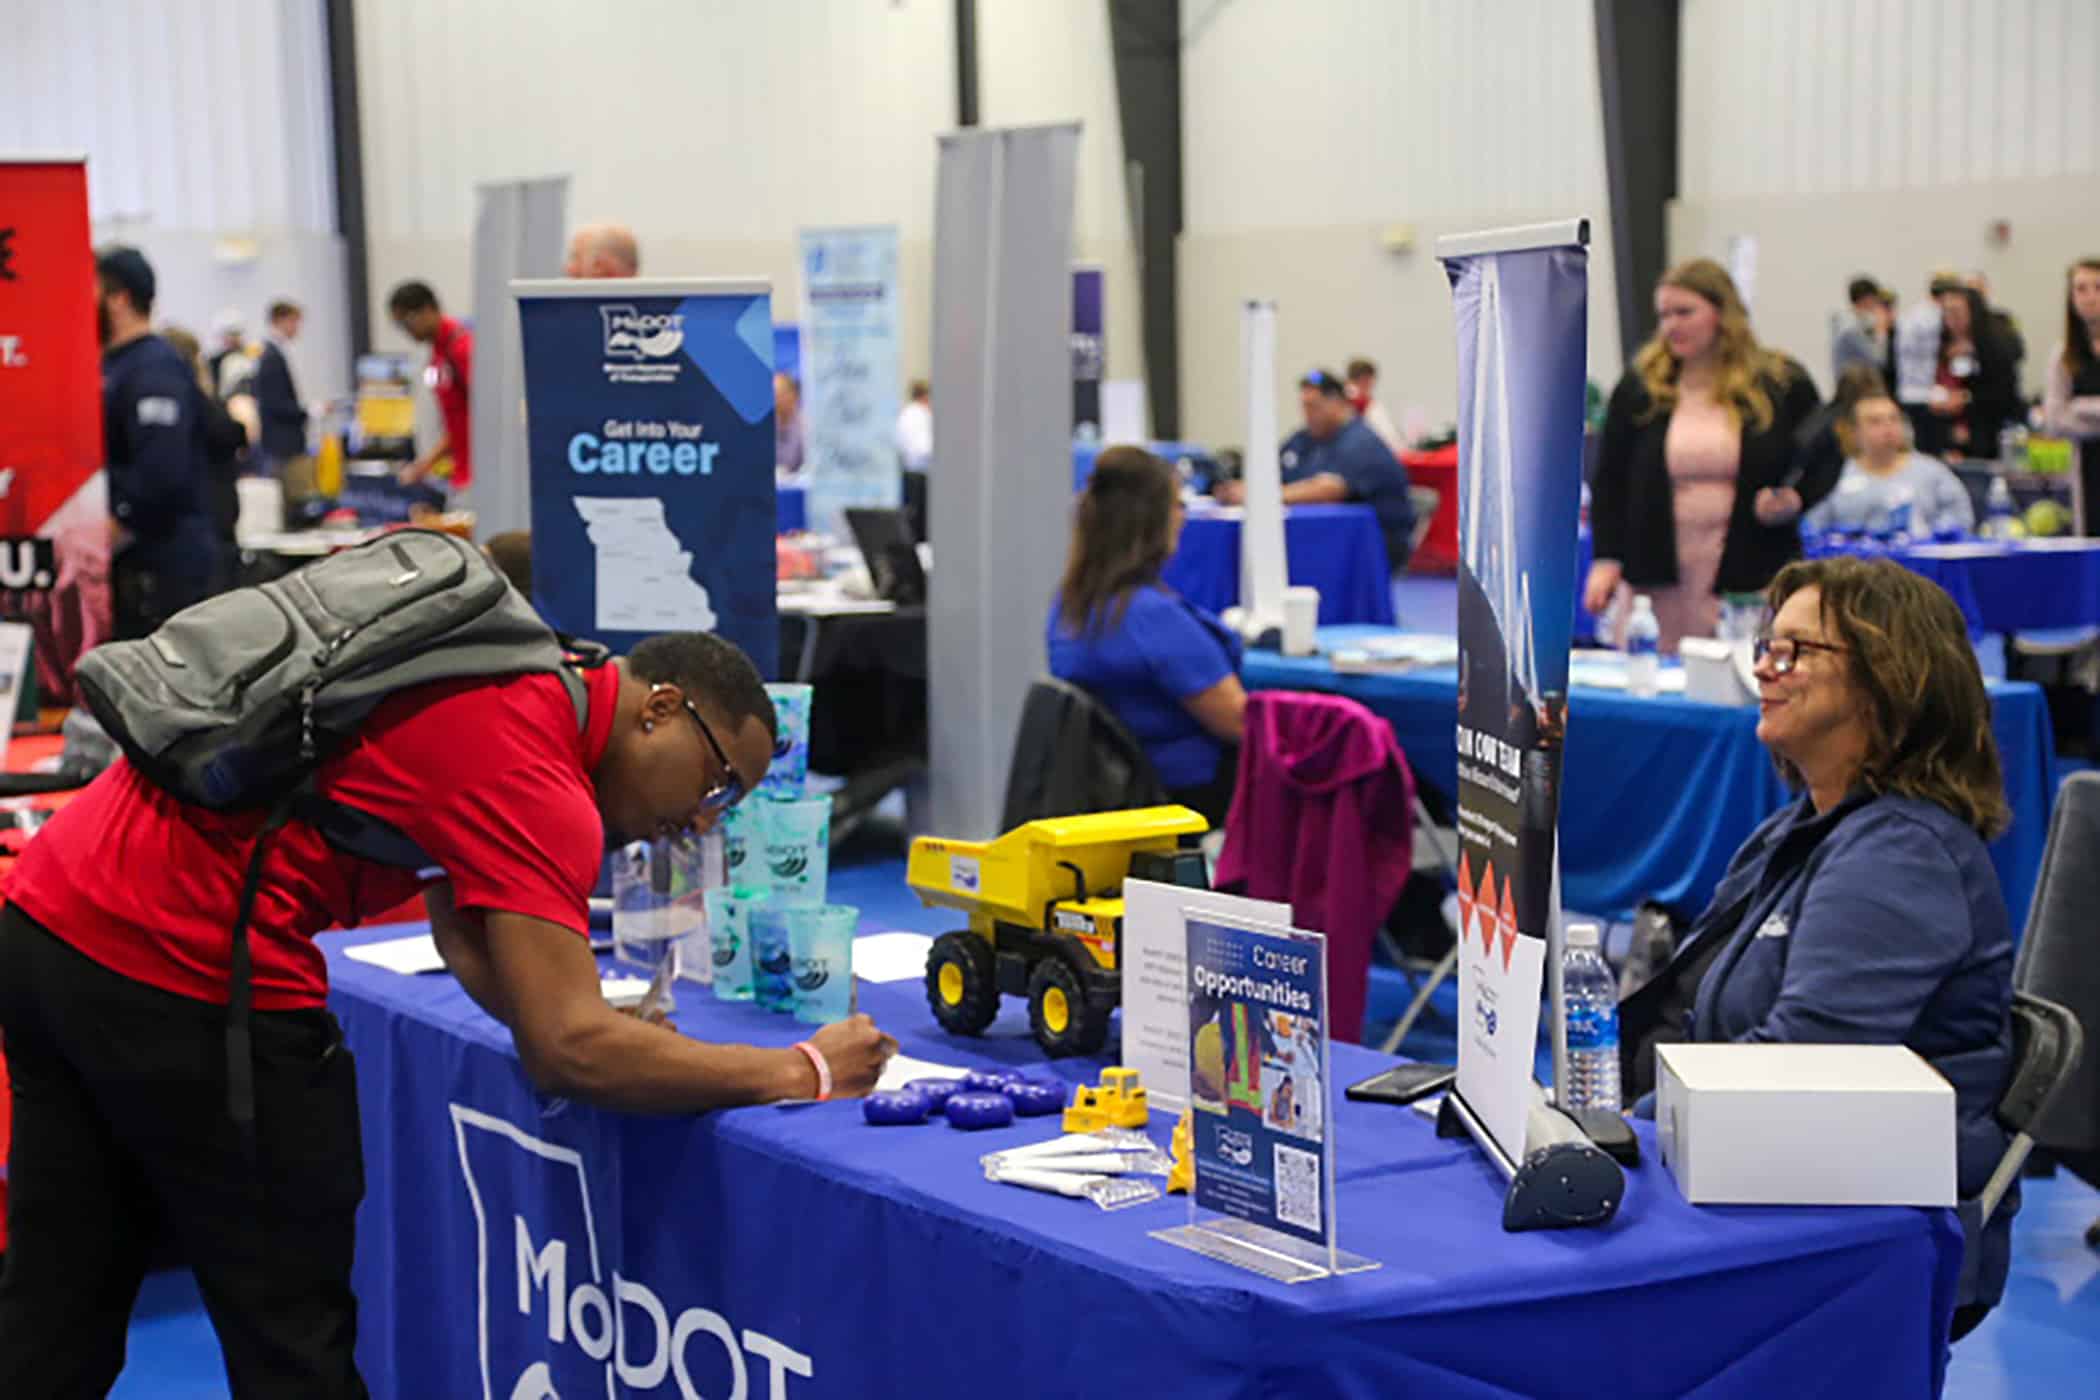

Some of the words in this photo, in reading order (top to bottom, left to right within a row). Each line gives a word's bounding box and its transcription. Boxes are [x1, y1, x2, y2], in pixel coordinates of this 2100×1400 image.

[603, 419, 633, 439] Get
[636, 420, 666, 439] Into
[667, 421, 703, 440] Your
[568, 432, 720, 474] Career
[1253, 944, 1307, 976] Career
[1194, 964, 1311, 1011] Opportunities
[514, 1213, 813, 1400] MoDOT
